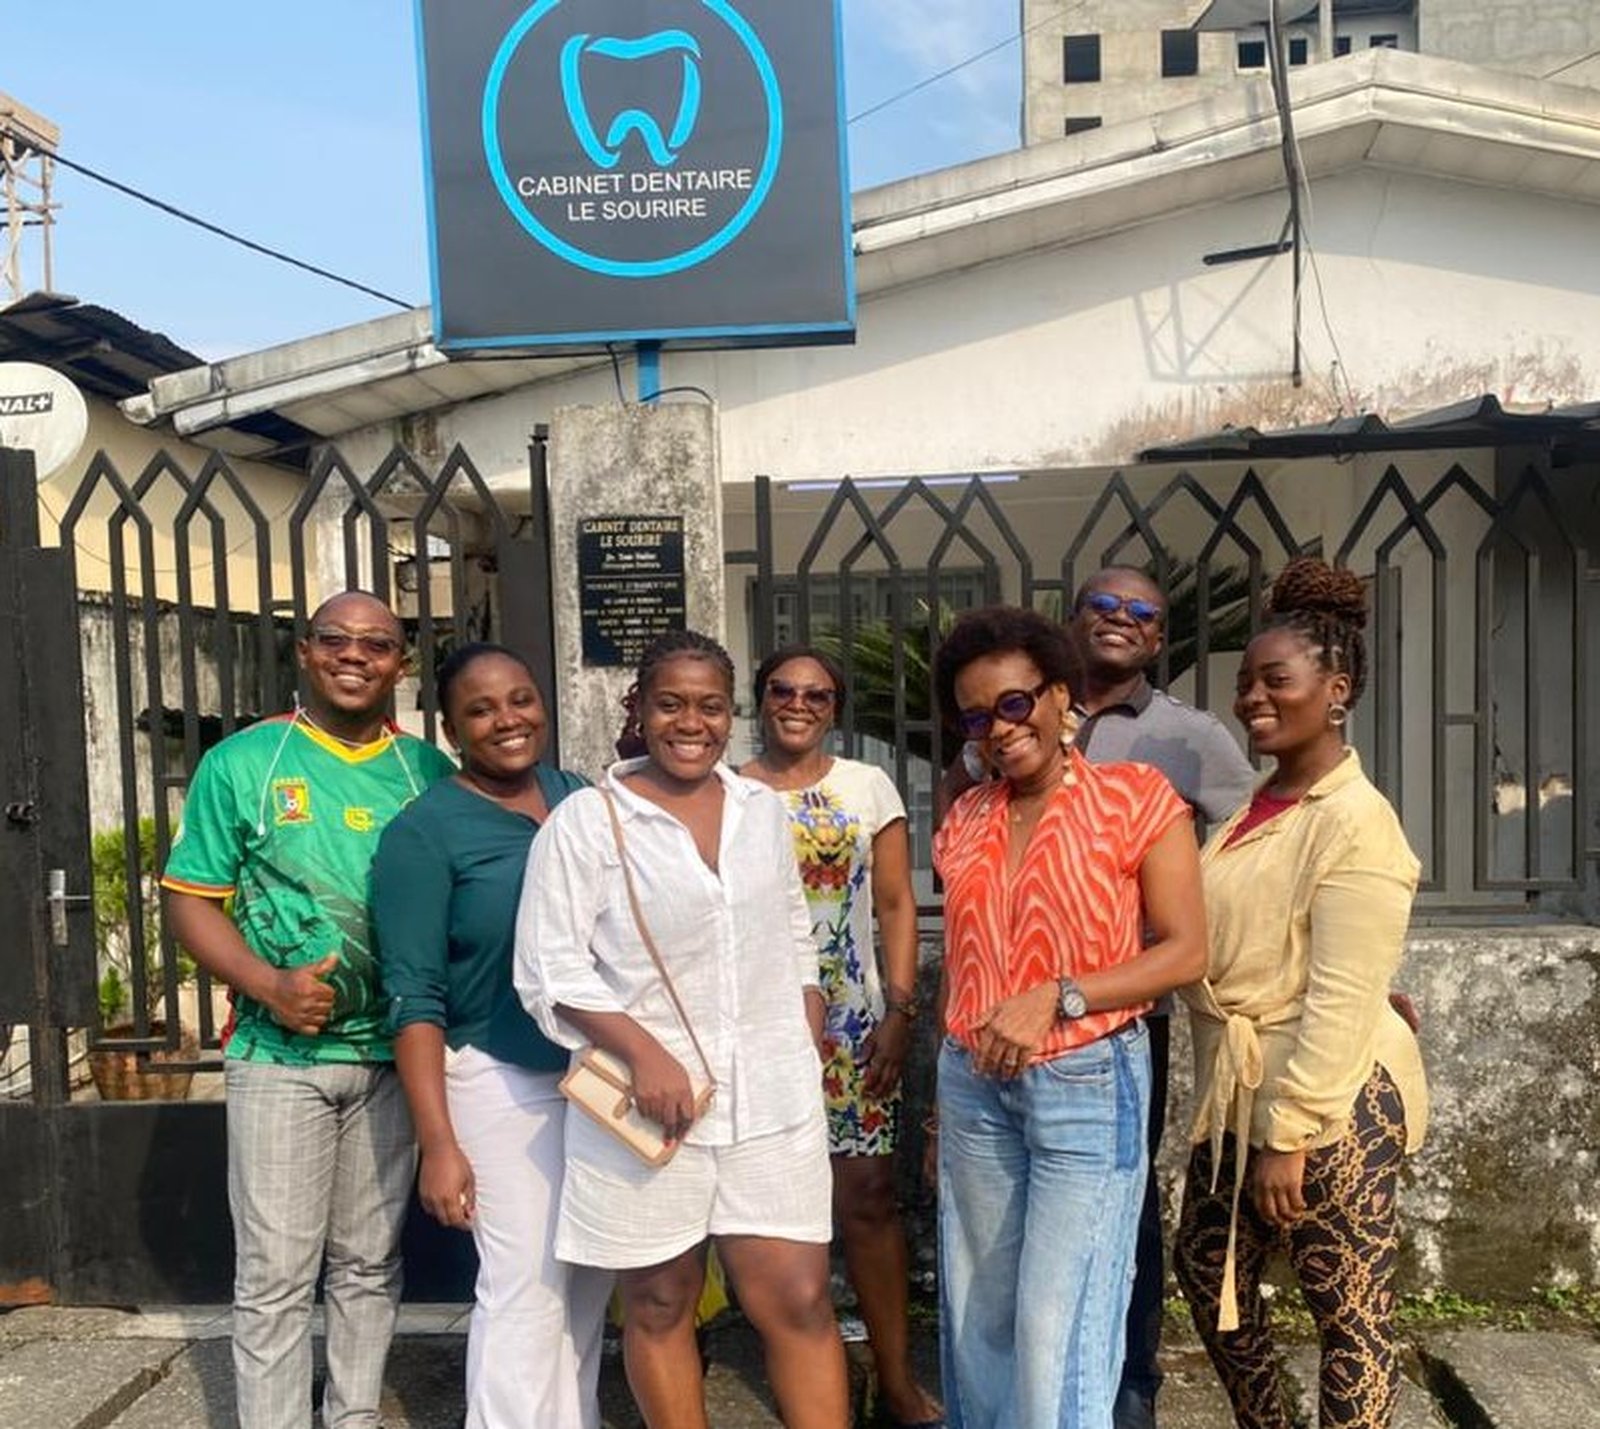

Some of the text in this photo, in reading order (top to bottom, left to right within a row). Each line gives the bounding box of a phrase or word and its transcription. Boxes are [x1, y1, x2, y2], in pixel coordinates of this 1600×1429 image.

[518, 169, 752, 197] CABINET DENTAIRE
[567, 198, 707, 221] LE SOURIRE
[583, 521, 625, 533] CABINET
[600, 534, 662, 548] LE SOURIRE
